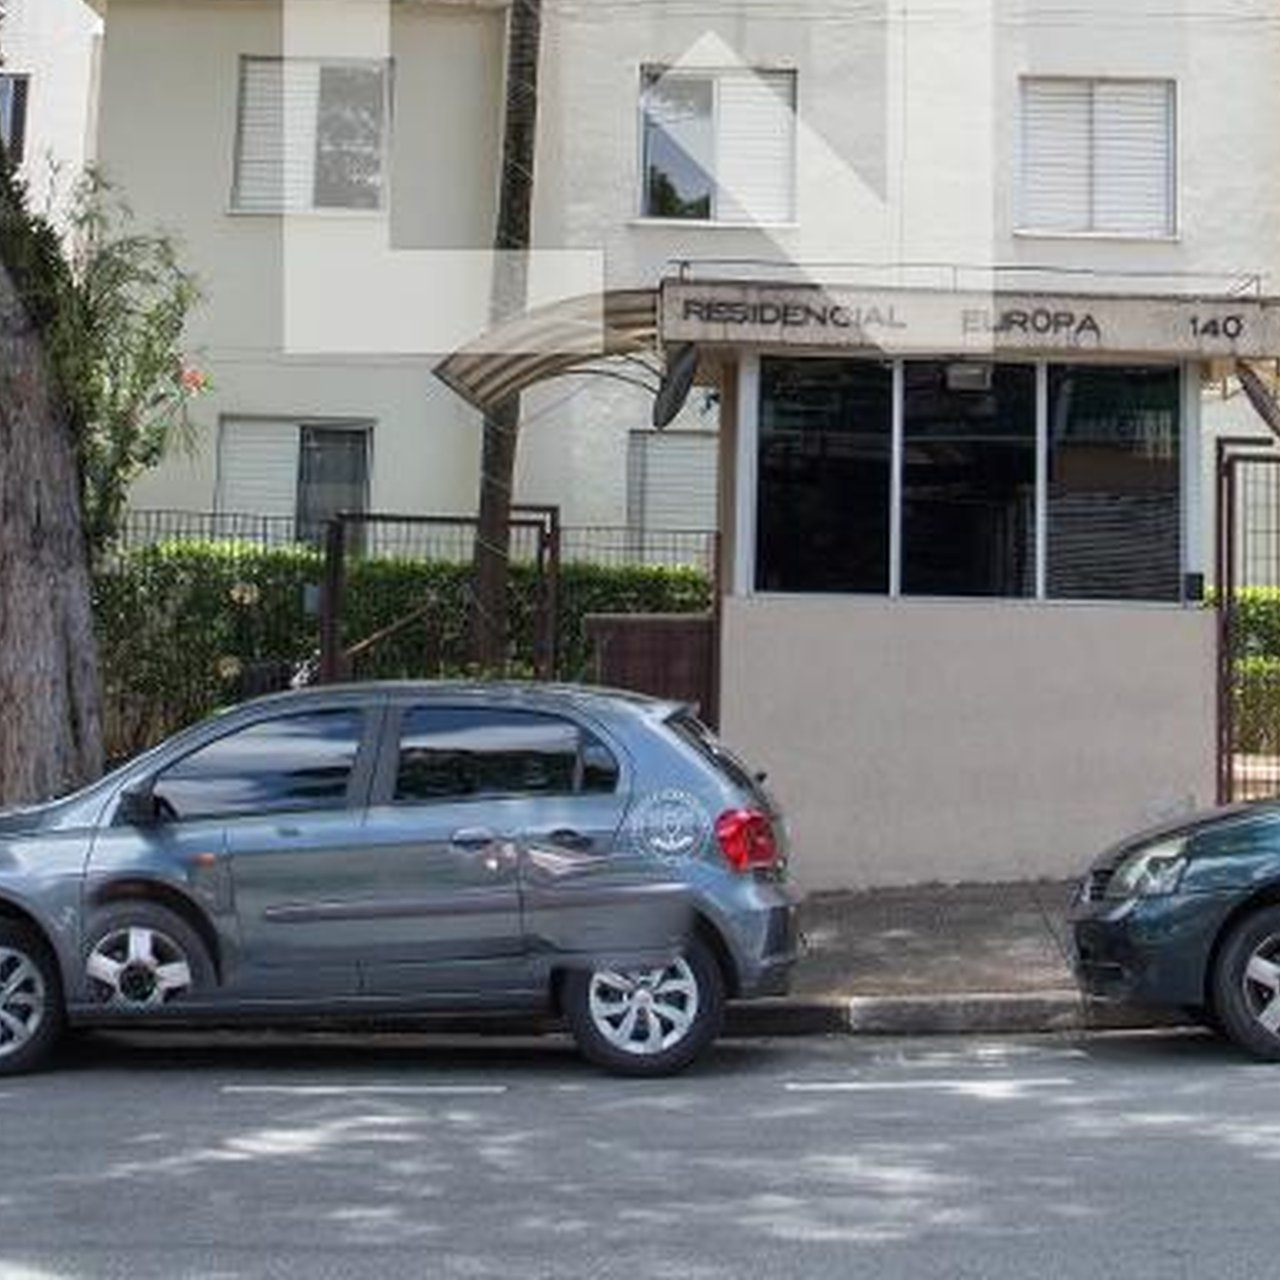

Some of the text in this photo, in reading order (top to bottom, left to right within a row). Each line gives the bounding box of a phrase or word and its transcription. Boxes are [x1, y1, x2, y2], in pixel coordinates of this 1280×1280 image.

[682, 298, 1244, 340] RESIDENCIAL EUROPA 140
